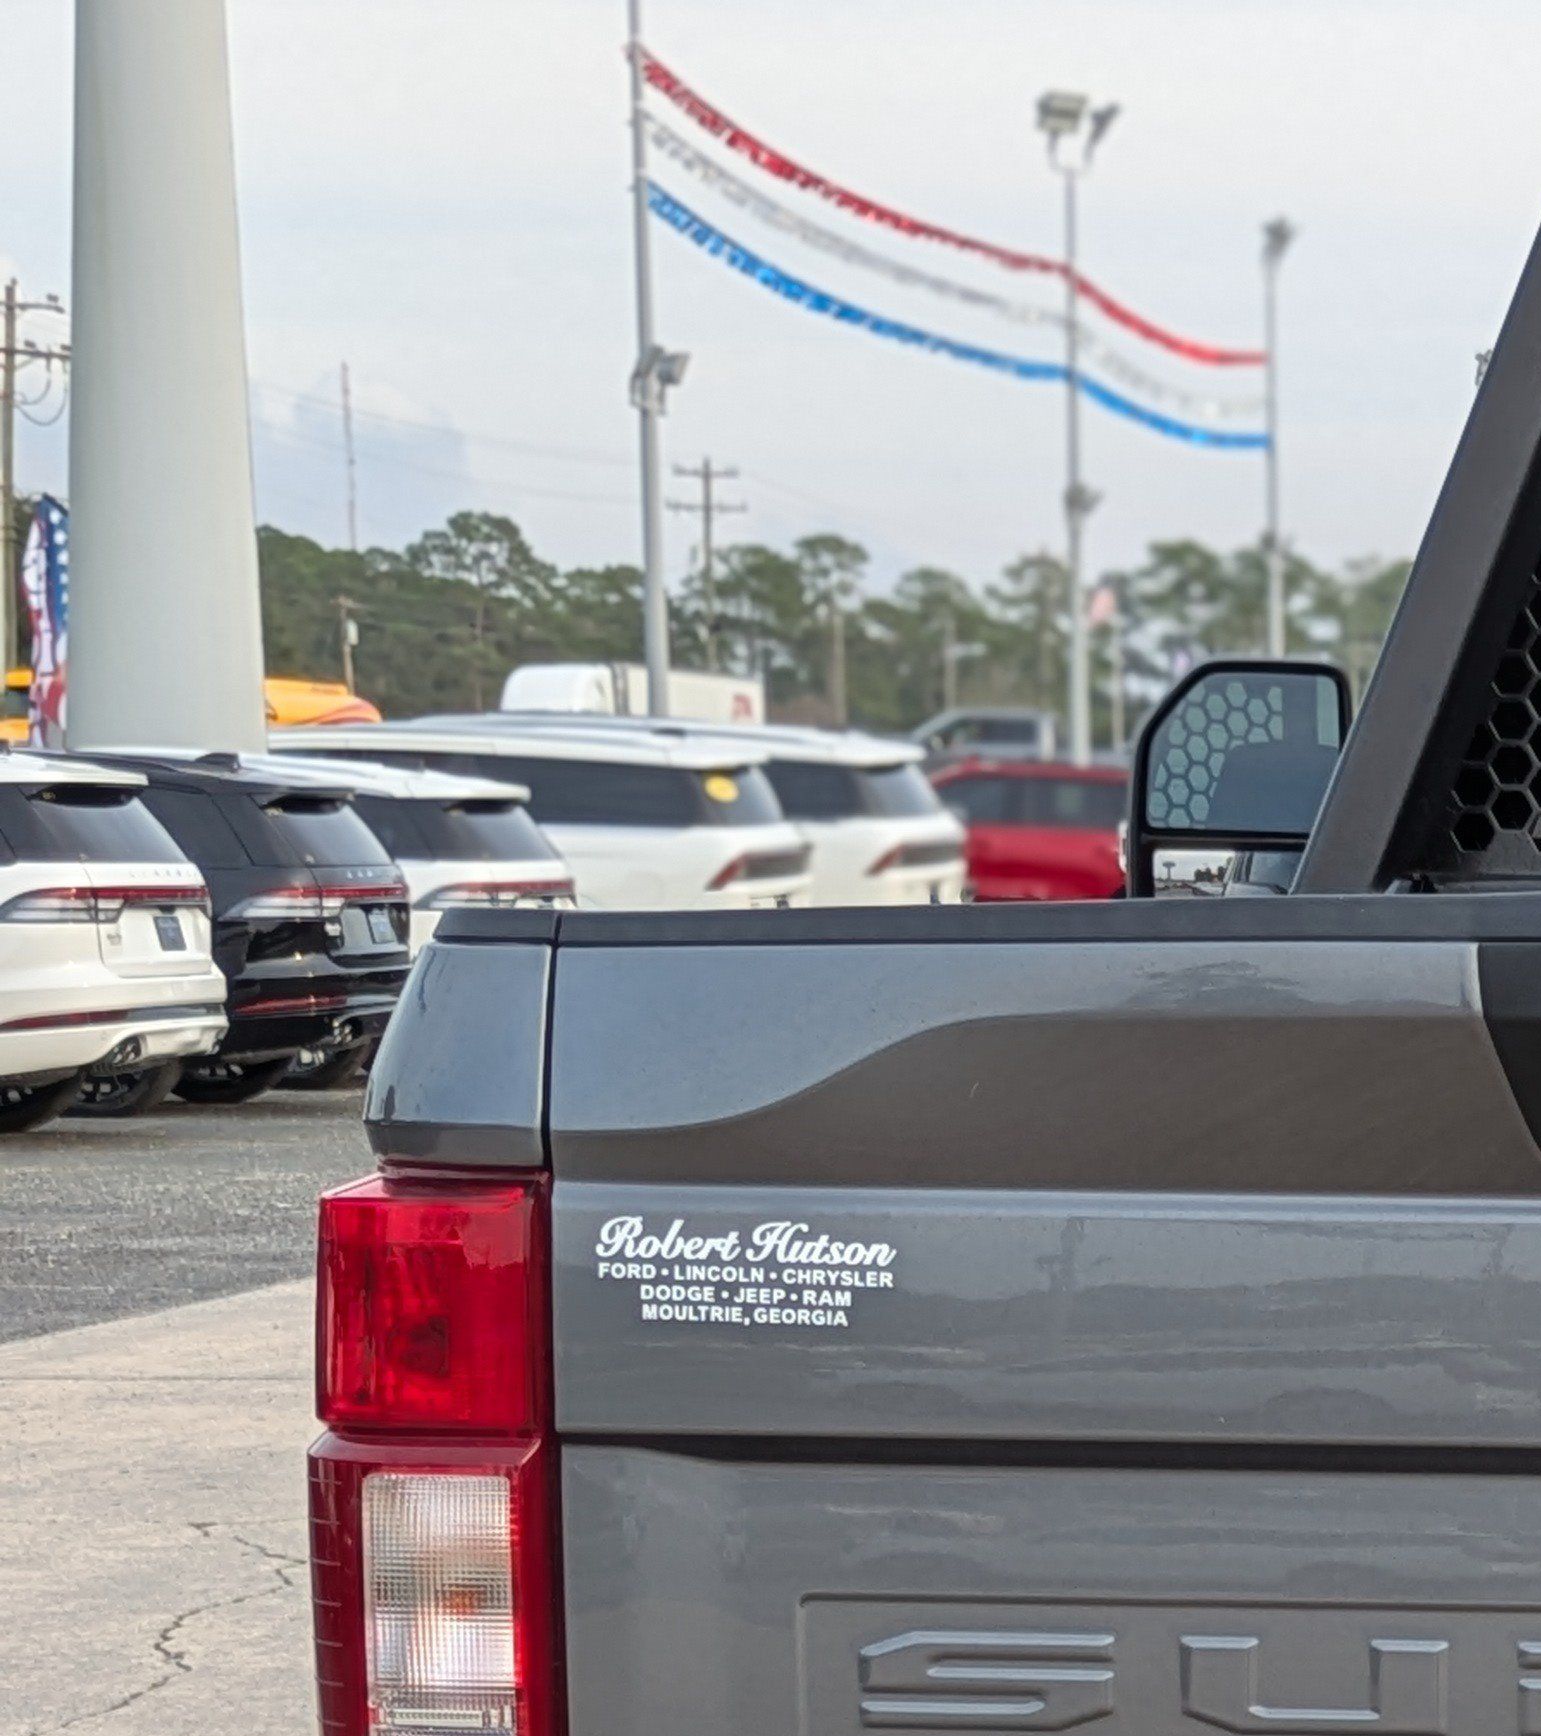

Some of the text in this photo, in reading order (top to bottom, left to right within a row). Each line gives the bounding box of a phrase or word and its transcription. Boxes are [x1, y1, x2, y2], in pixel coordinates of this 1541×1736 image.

[595, 1215, 897, 1267] Robert Hutson
[598, 1262, 894, 1288] FORD LINCOLN CHRYSLER
[640, 1284, 852, 1307] DODGE JEEP RAM
[641, 1303, 849, 1327] MOULTRIE, GEORGIA
